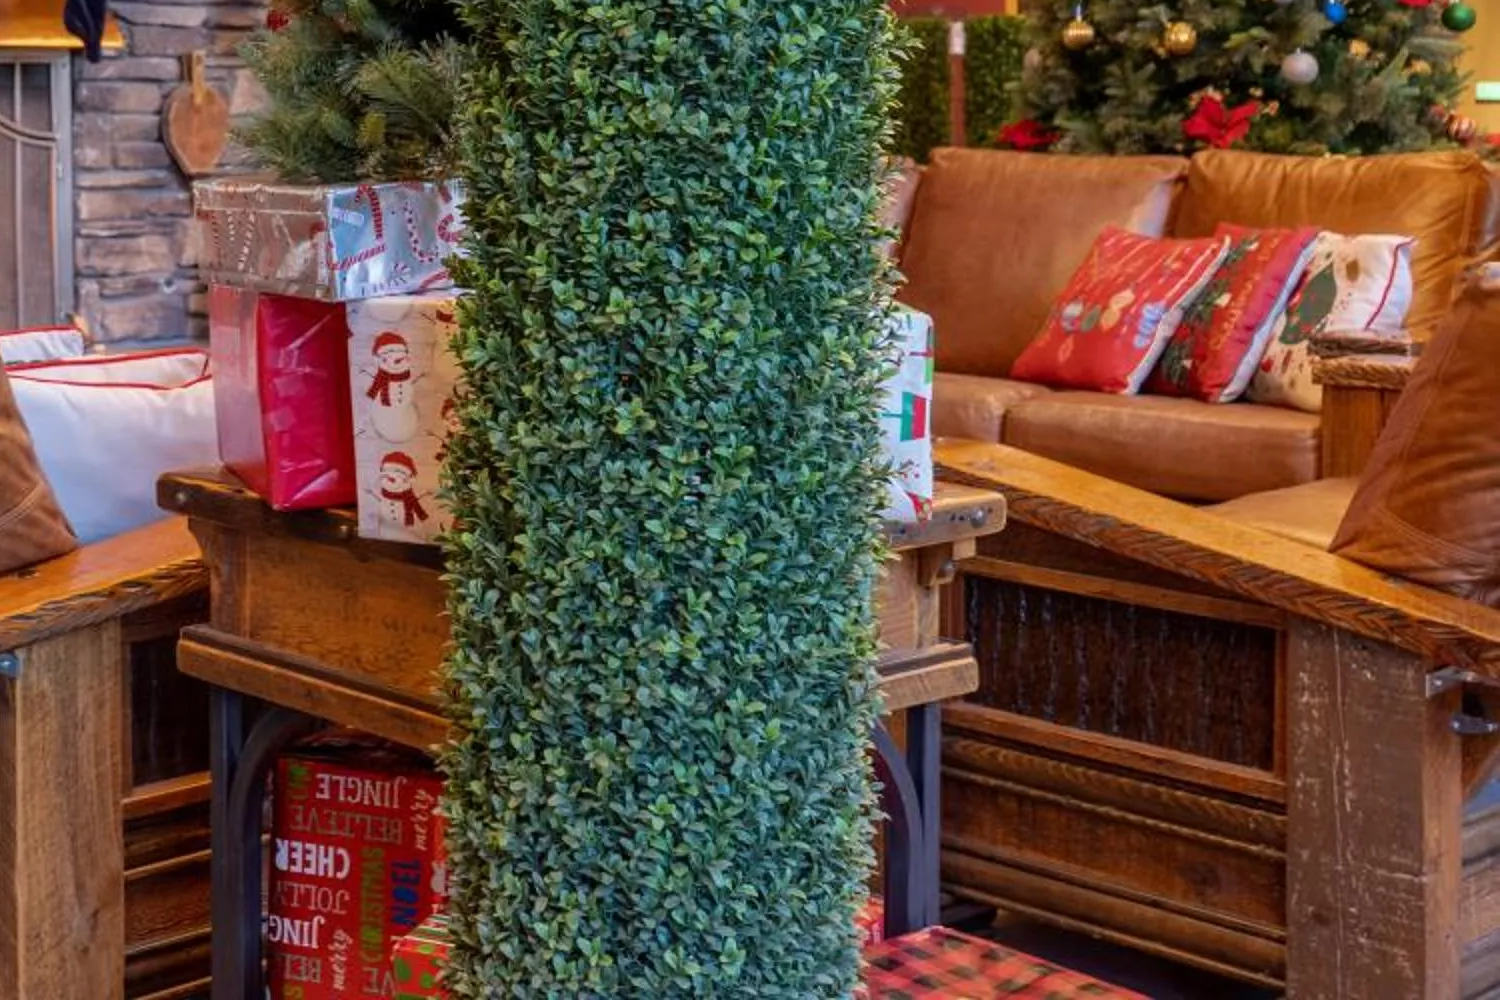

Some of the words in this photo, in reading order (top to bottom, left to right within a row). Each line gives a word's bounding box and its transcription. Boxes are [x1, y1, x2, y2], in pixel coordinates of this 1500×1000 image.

[316, 773, 406, 808] JINGLE
[290, 804, 403, 844] BELIEVE
[411, 788, 434, 850] merry
[275, 838, 350, 879] CHEER
[391, 860, 421, 926] NOEL
[328, 929, 353, 991] merry
